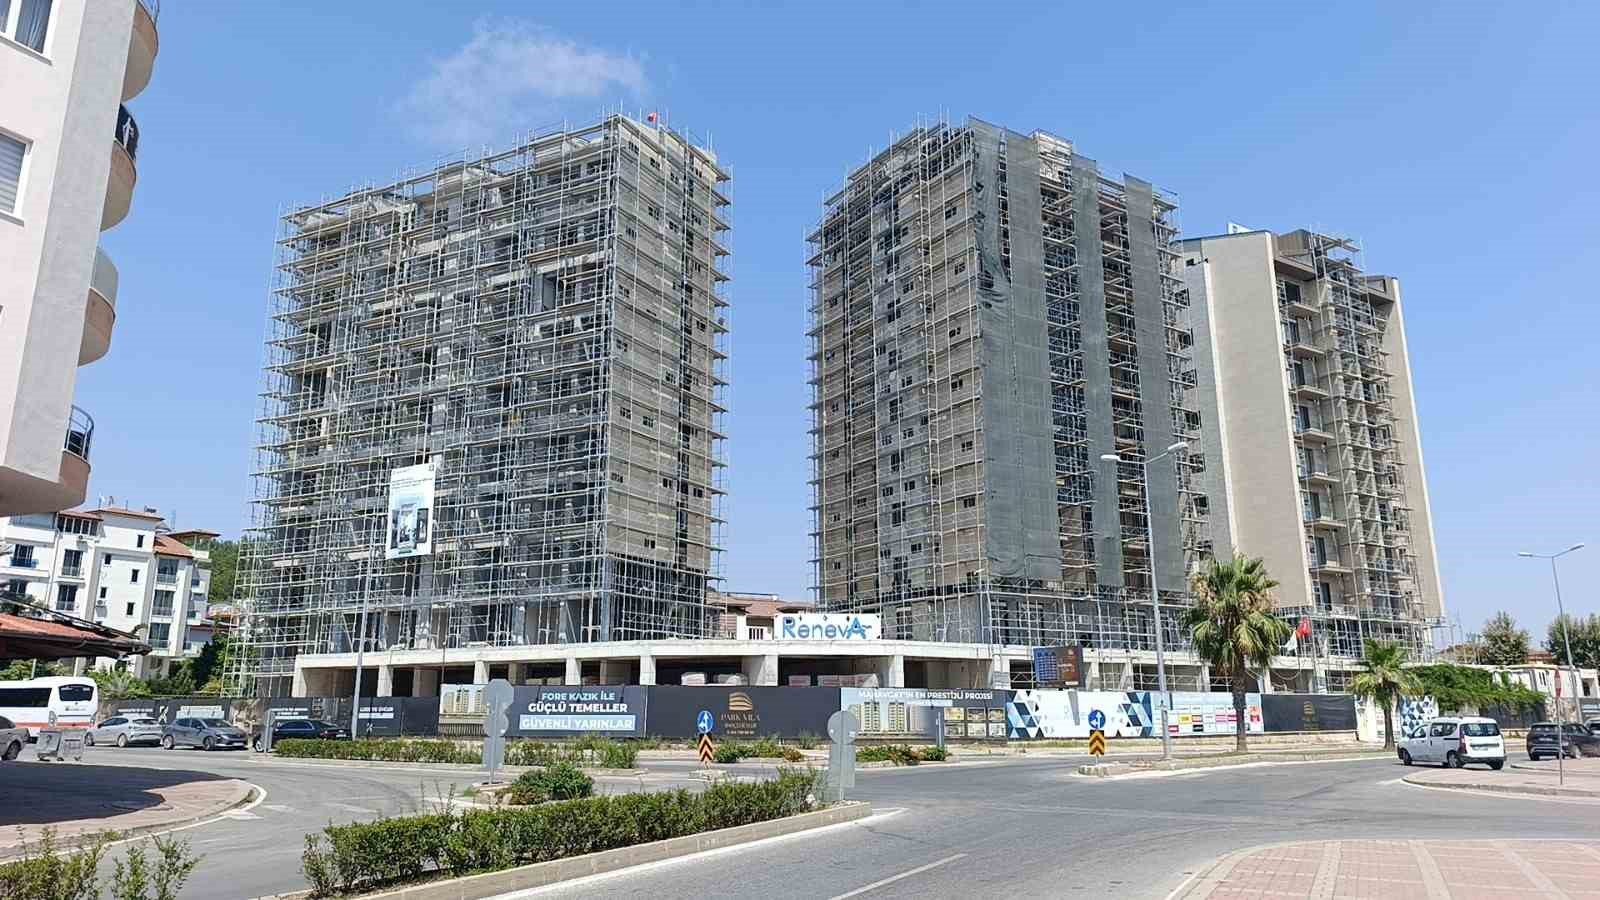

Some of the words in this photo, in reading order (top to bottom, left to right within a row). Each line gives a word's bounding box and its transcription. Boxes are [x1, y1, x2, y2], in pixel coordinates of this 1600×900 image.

[542, 692, 567, 701] FORE
[569, 692, 599, 701] KAZIK
[600, 690, 616, 701] İLE
[528, 701, 567, 715] GÜÇLÜ
[569, 703, 628, 713] TEMELLER
[574, 718, 633, 730] YARINLAR
